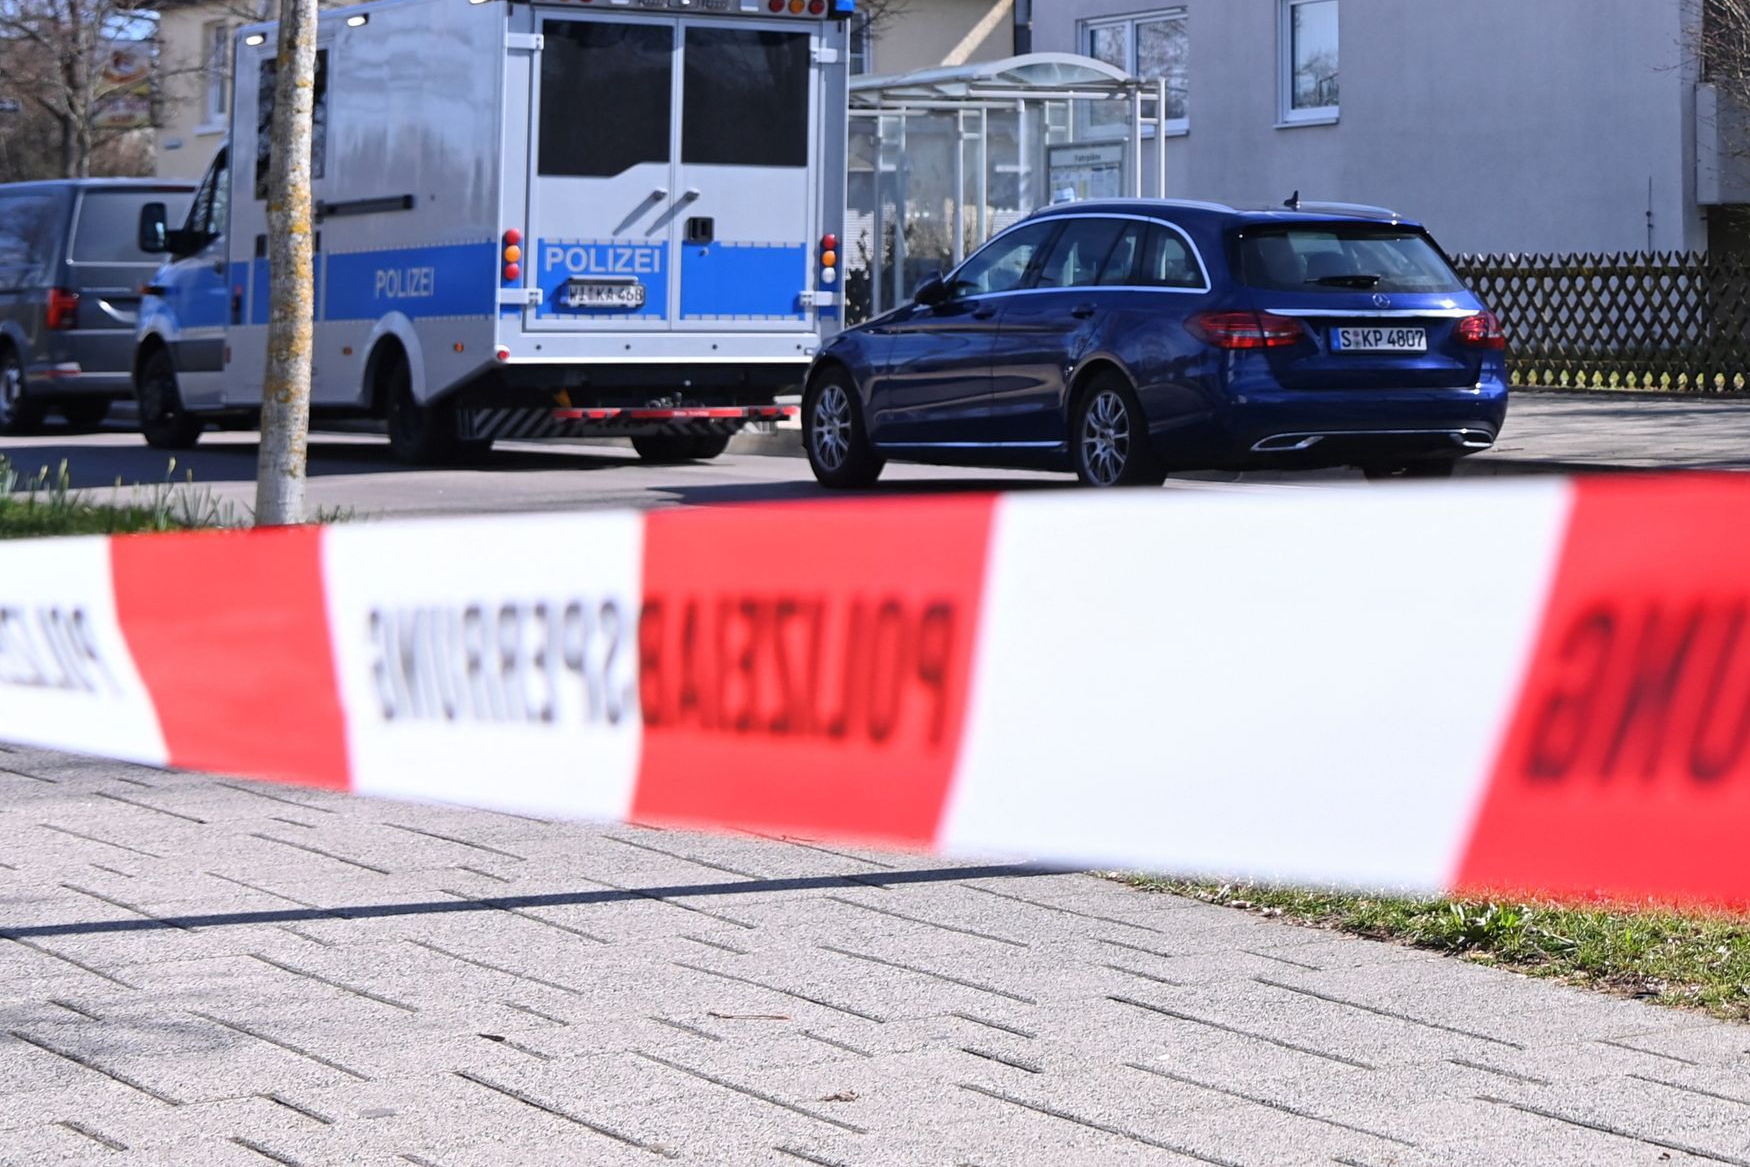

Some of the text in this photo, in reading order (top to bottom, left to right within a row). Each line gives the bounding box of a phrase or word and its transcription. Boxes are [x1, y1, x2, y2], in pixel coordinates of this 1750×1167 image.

[545, 246, 661, 273] POLIZEI
[375, 266, 435, 298] POLIZEI
[1341, 329, 1424, 348] S KP 4807
